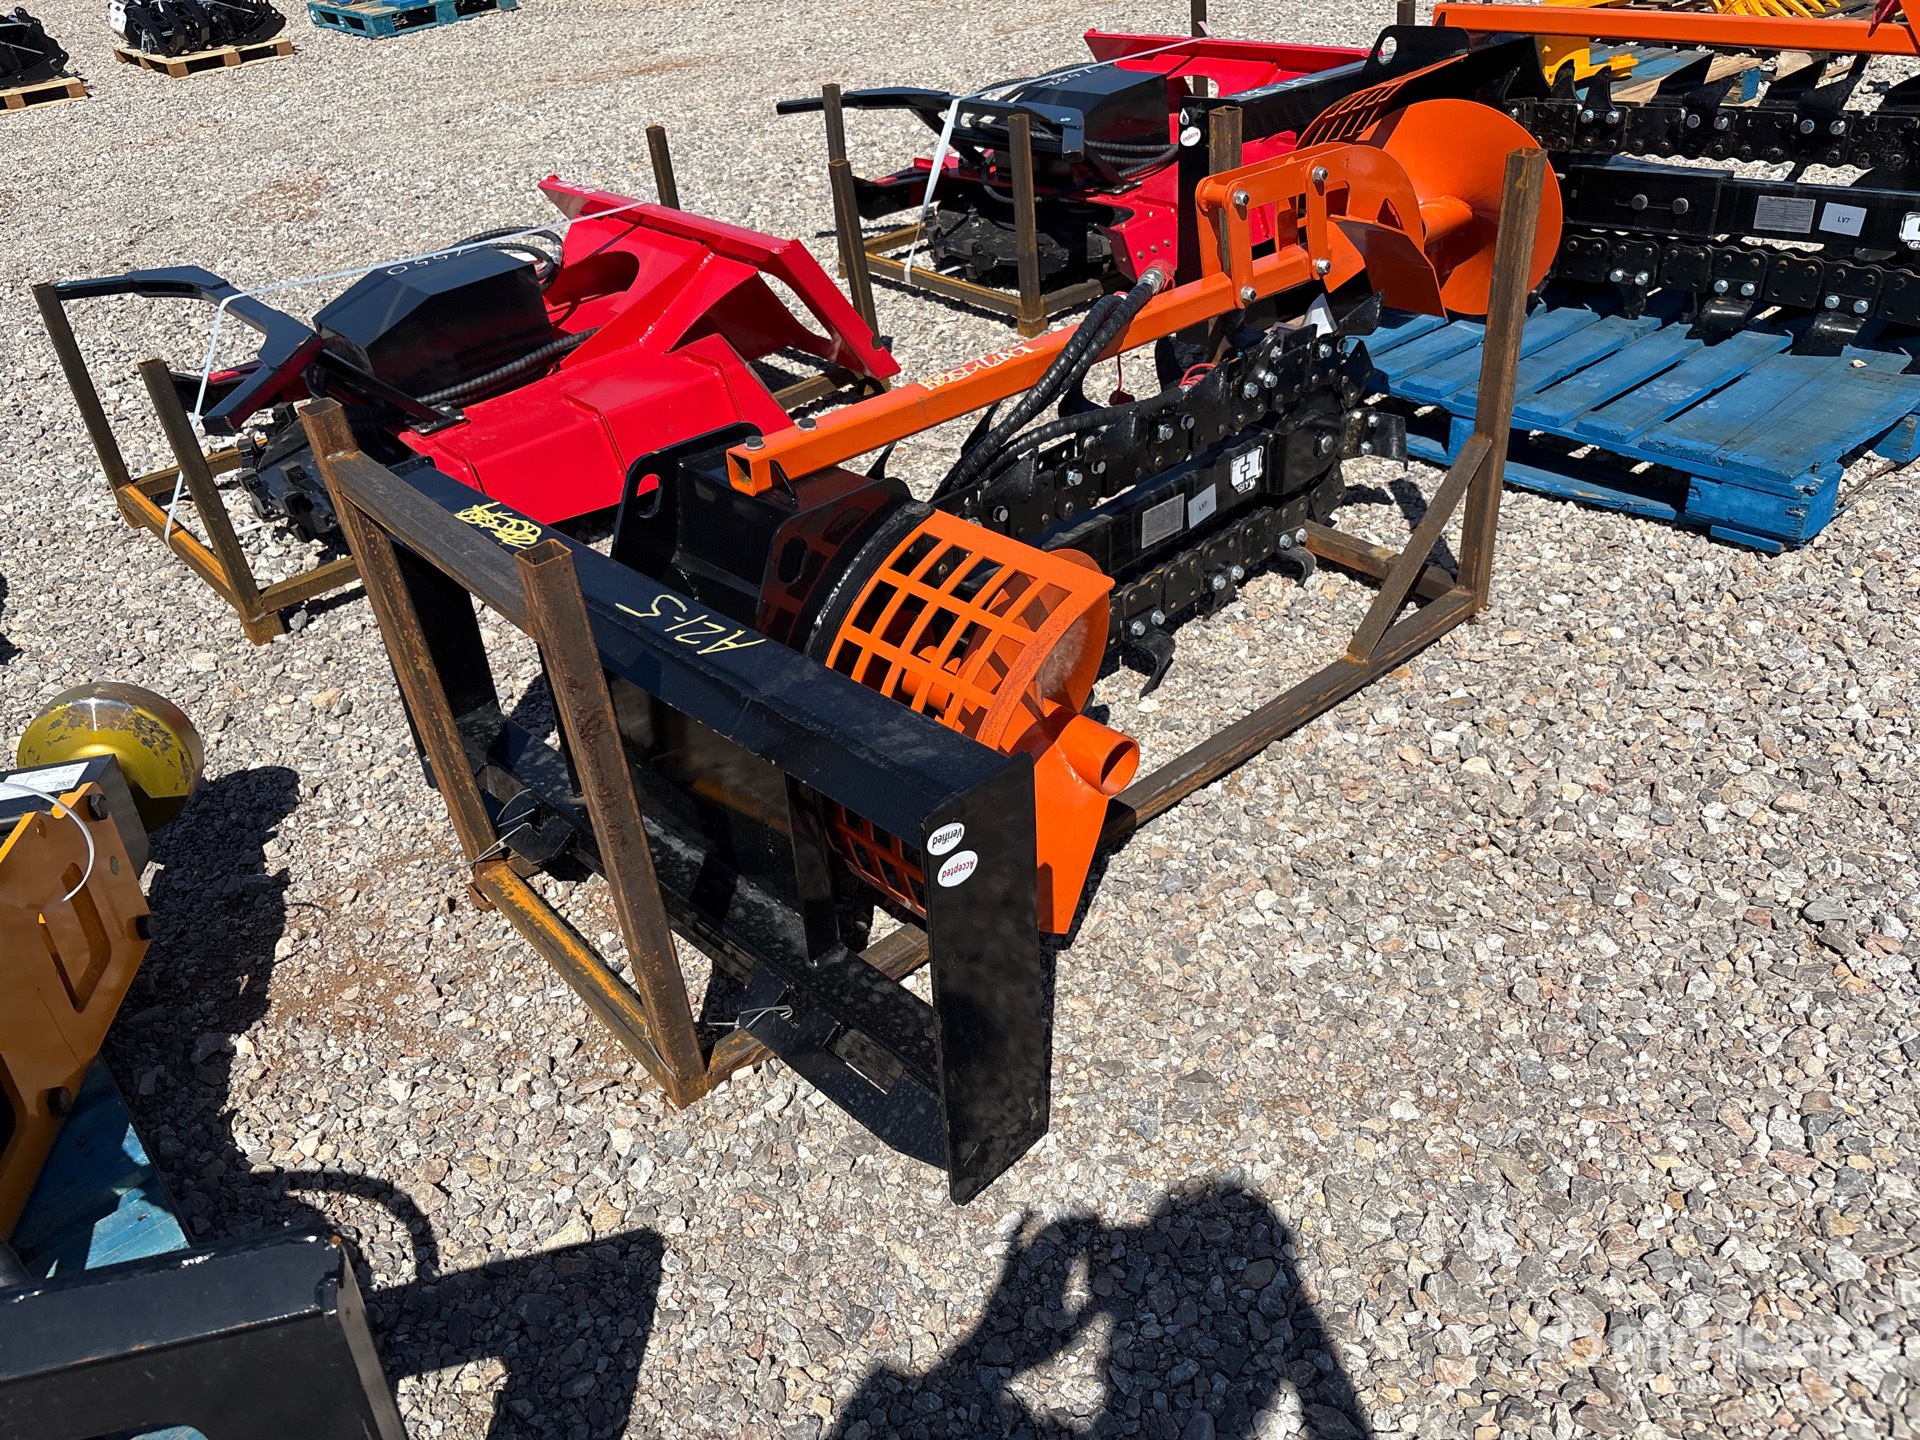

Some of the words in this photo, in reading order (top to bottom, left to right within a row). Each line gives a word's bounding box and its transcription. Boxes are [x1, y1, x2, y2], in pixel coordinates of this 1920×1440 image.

[1837, 216, 1850, 224] LV7
[615, 594, 767, 656] A21-5
[931, 827, 963, 849] Verified
[941, 859, 976, 882] Accepted
